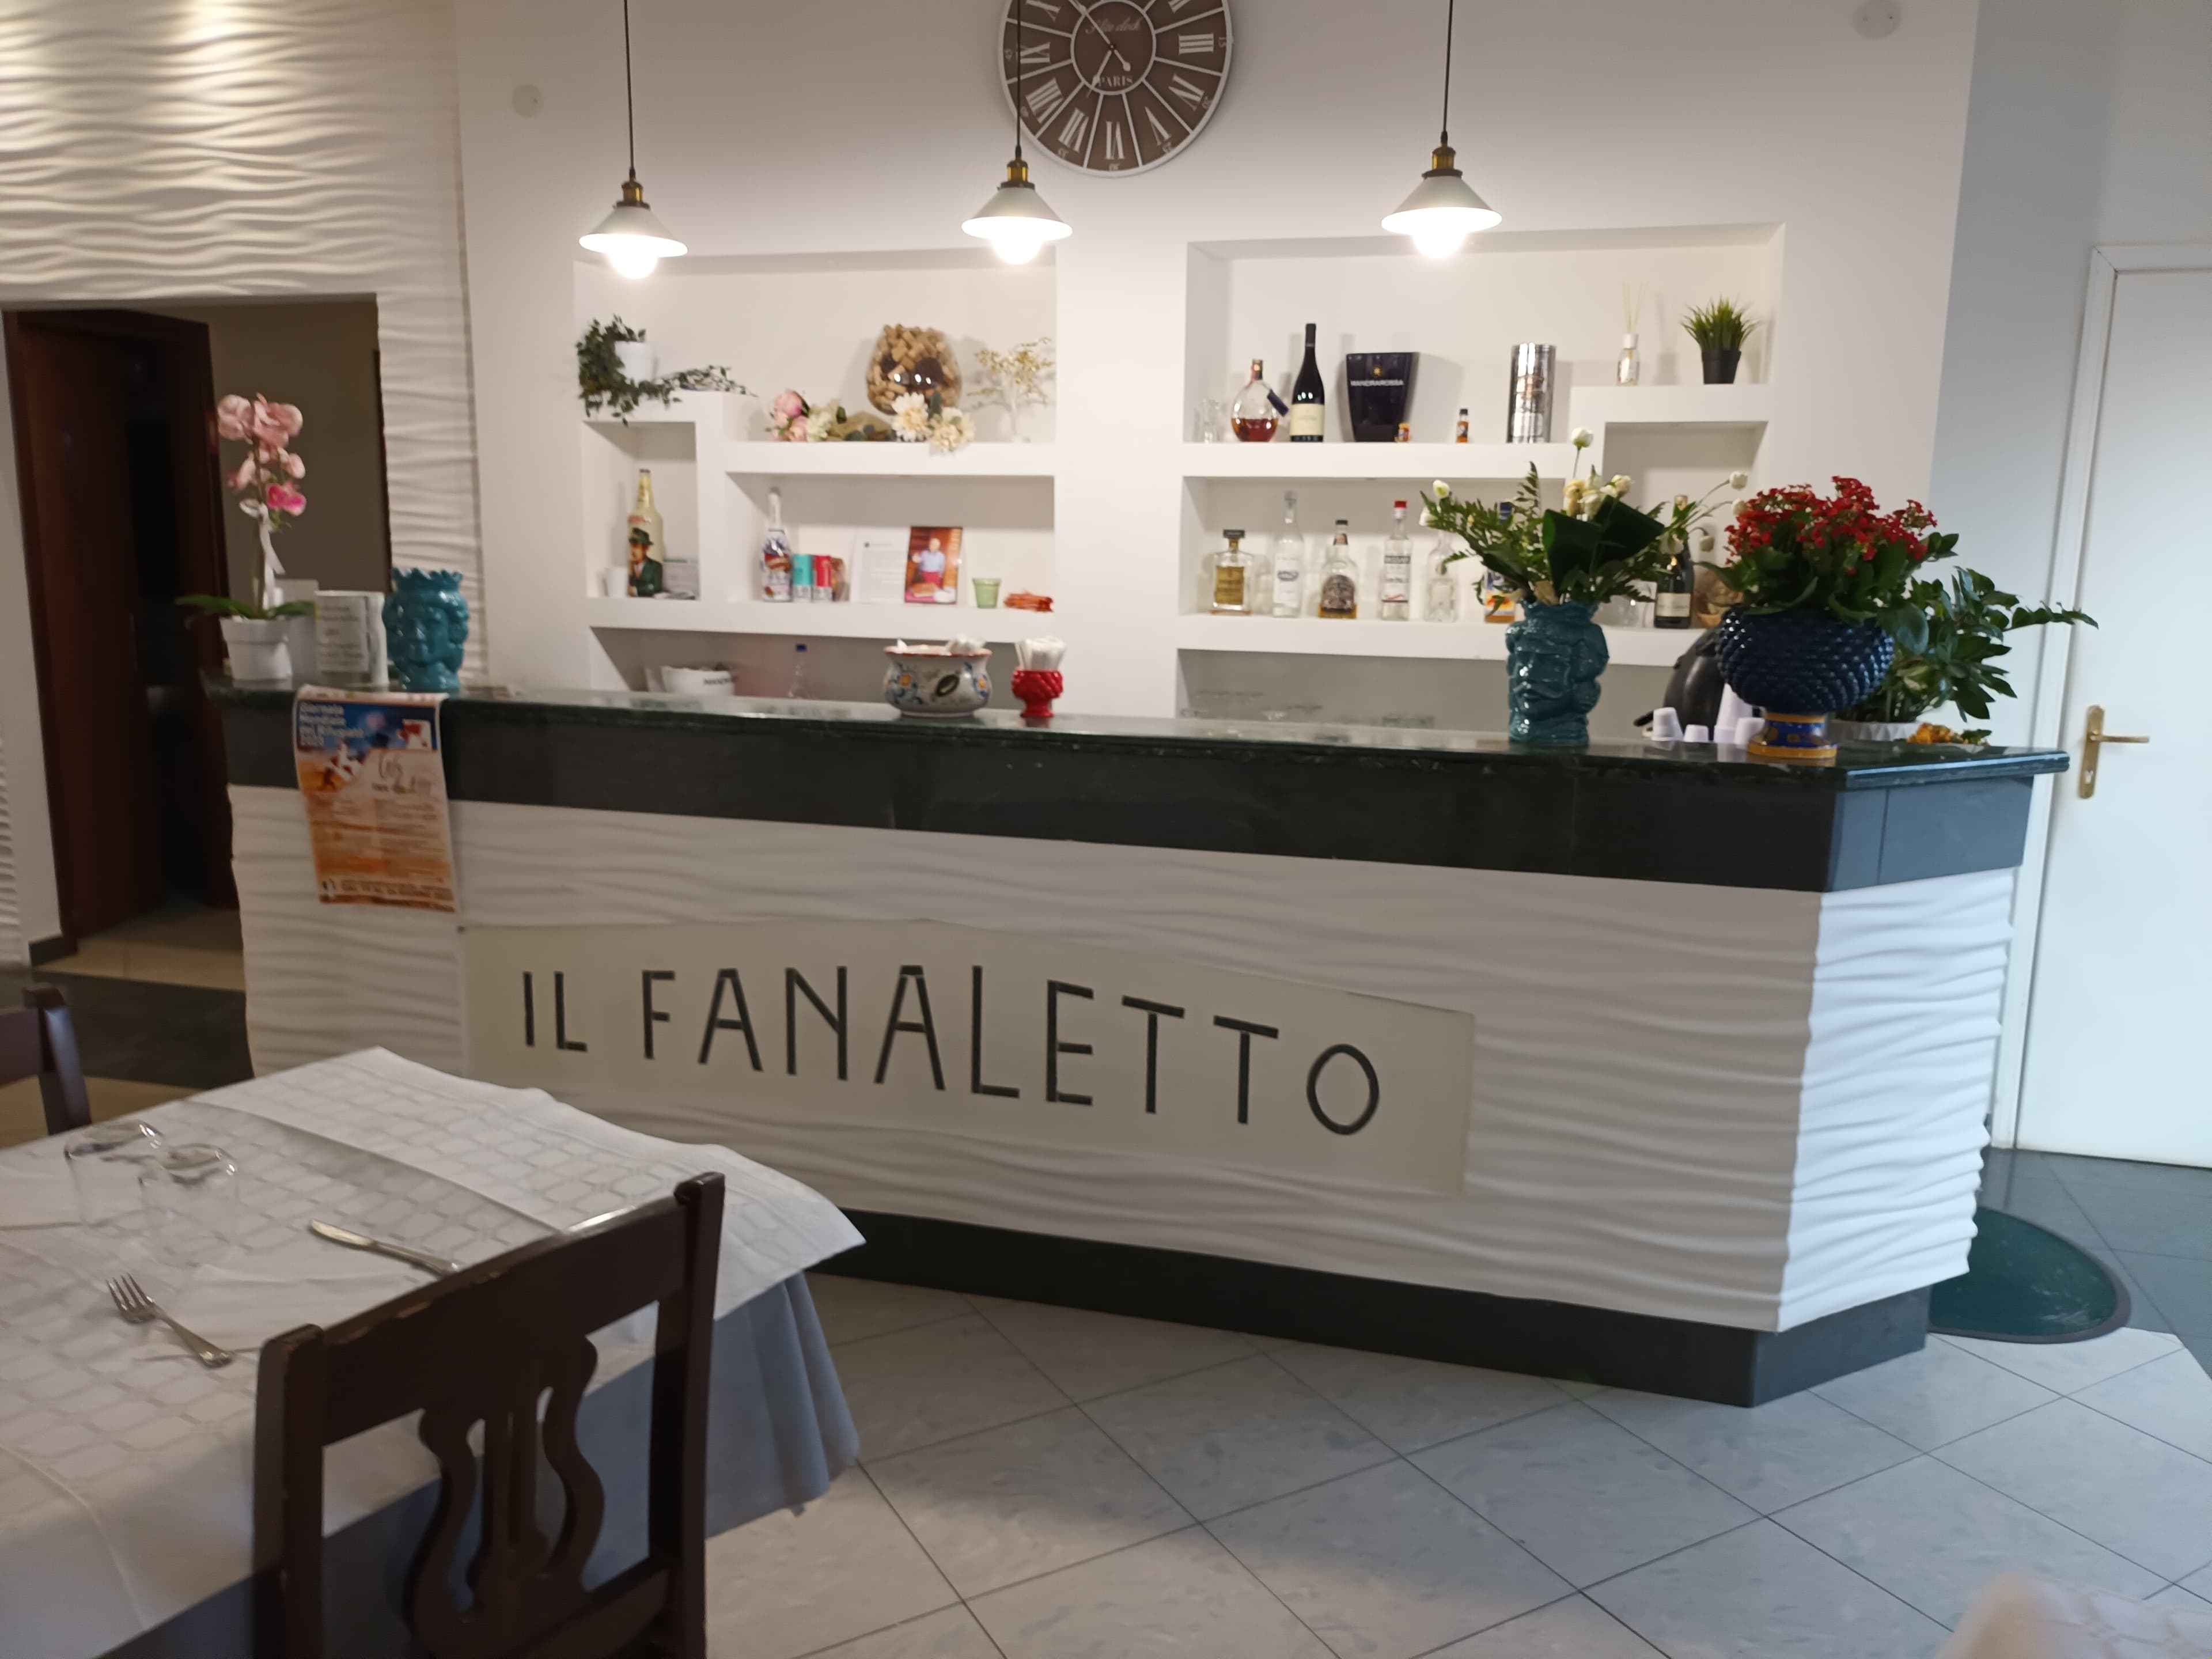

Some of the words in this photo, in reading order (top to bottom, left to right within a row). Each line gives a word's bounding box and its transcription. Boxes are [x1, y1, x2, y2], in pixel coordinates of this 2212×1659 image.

[1178, 33, 1214, 55] III
[1025, 77, 1064, 124] VIII
[1168, 73, 1205, 111] IV
[1058, 107, 1089, 153] VII
[1105, 120, 1125, 160] VI
[1144, 106, 1172, 146] V
[523, 971, 588, 1053] IL
[641, 964, 1380, 1136] FANALETTO
